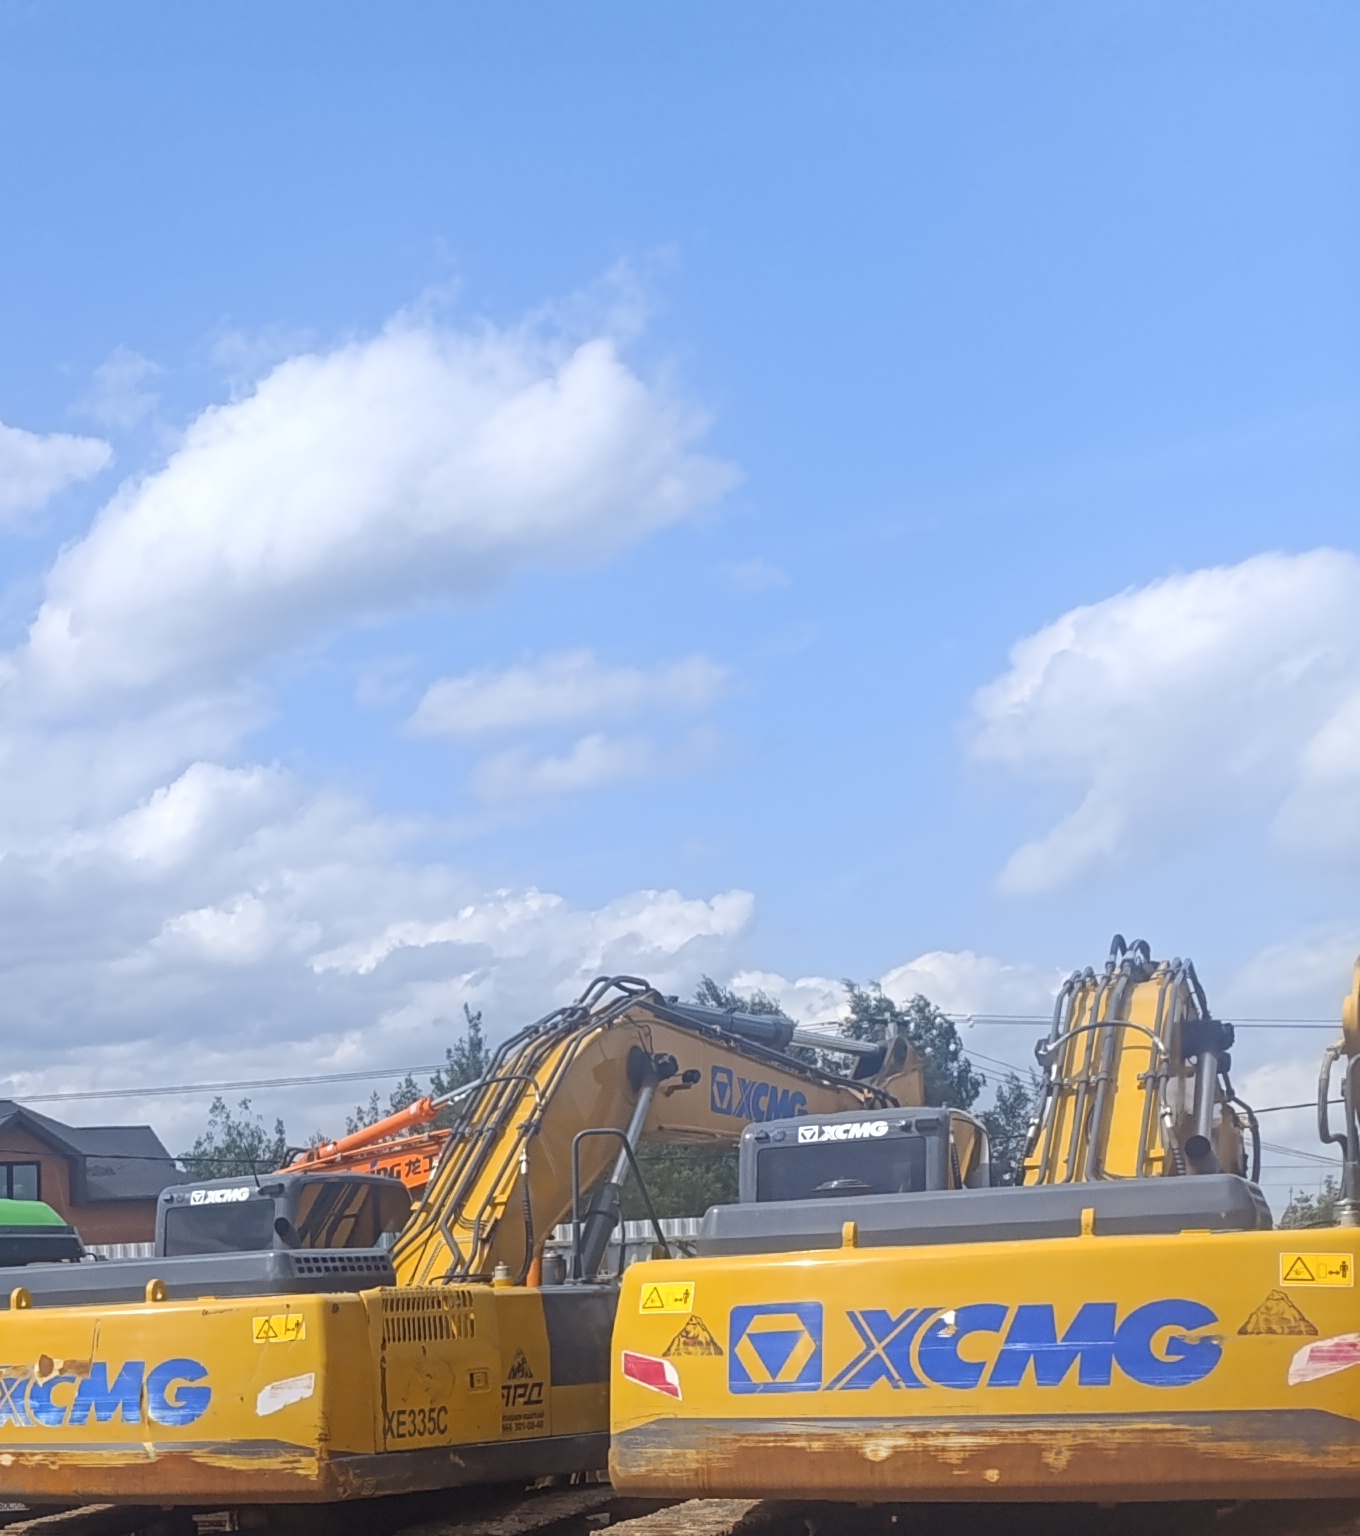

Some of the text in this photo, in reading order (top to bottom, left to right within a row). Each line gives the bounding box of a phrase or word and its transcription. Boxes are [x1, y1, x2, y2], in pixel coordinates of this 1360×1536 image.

[817, 1120, 889, 1141] XCMG
[204, 1187, 250, 1205] XCMG
[821, 1298, 1224, 1391] XCMG
[384, 1405, 449, 1440] XE335C
